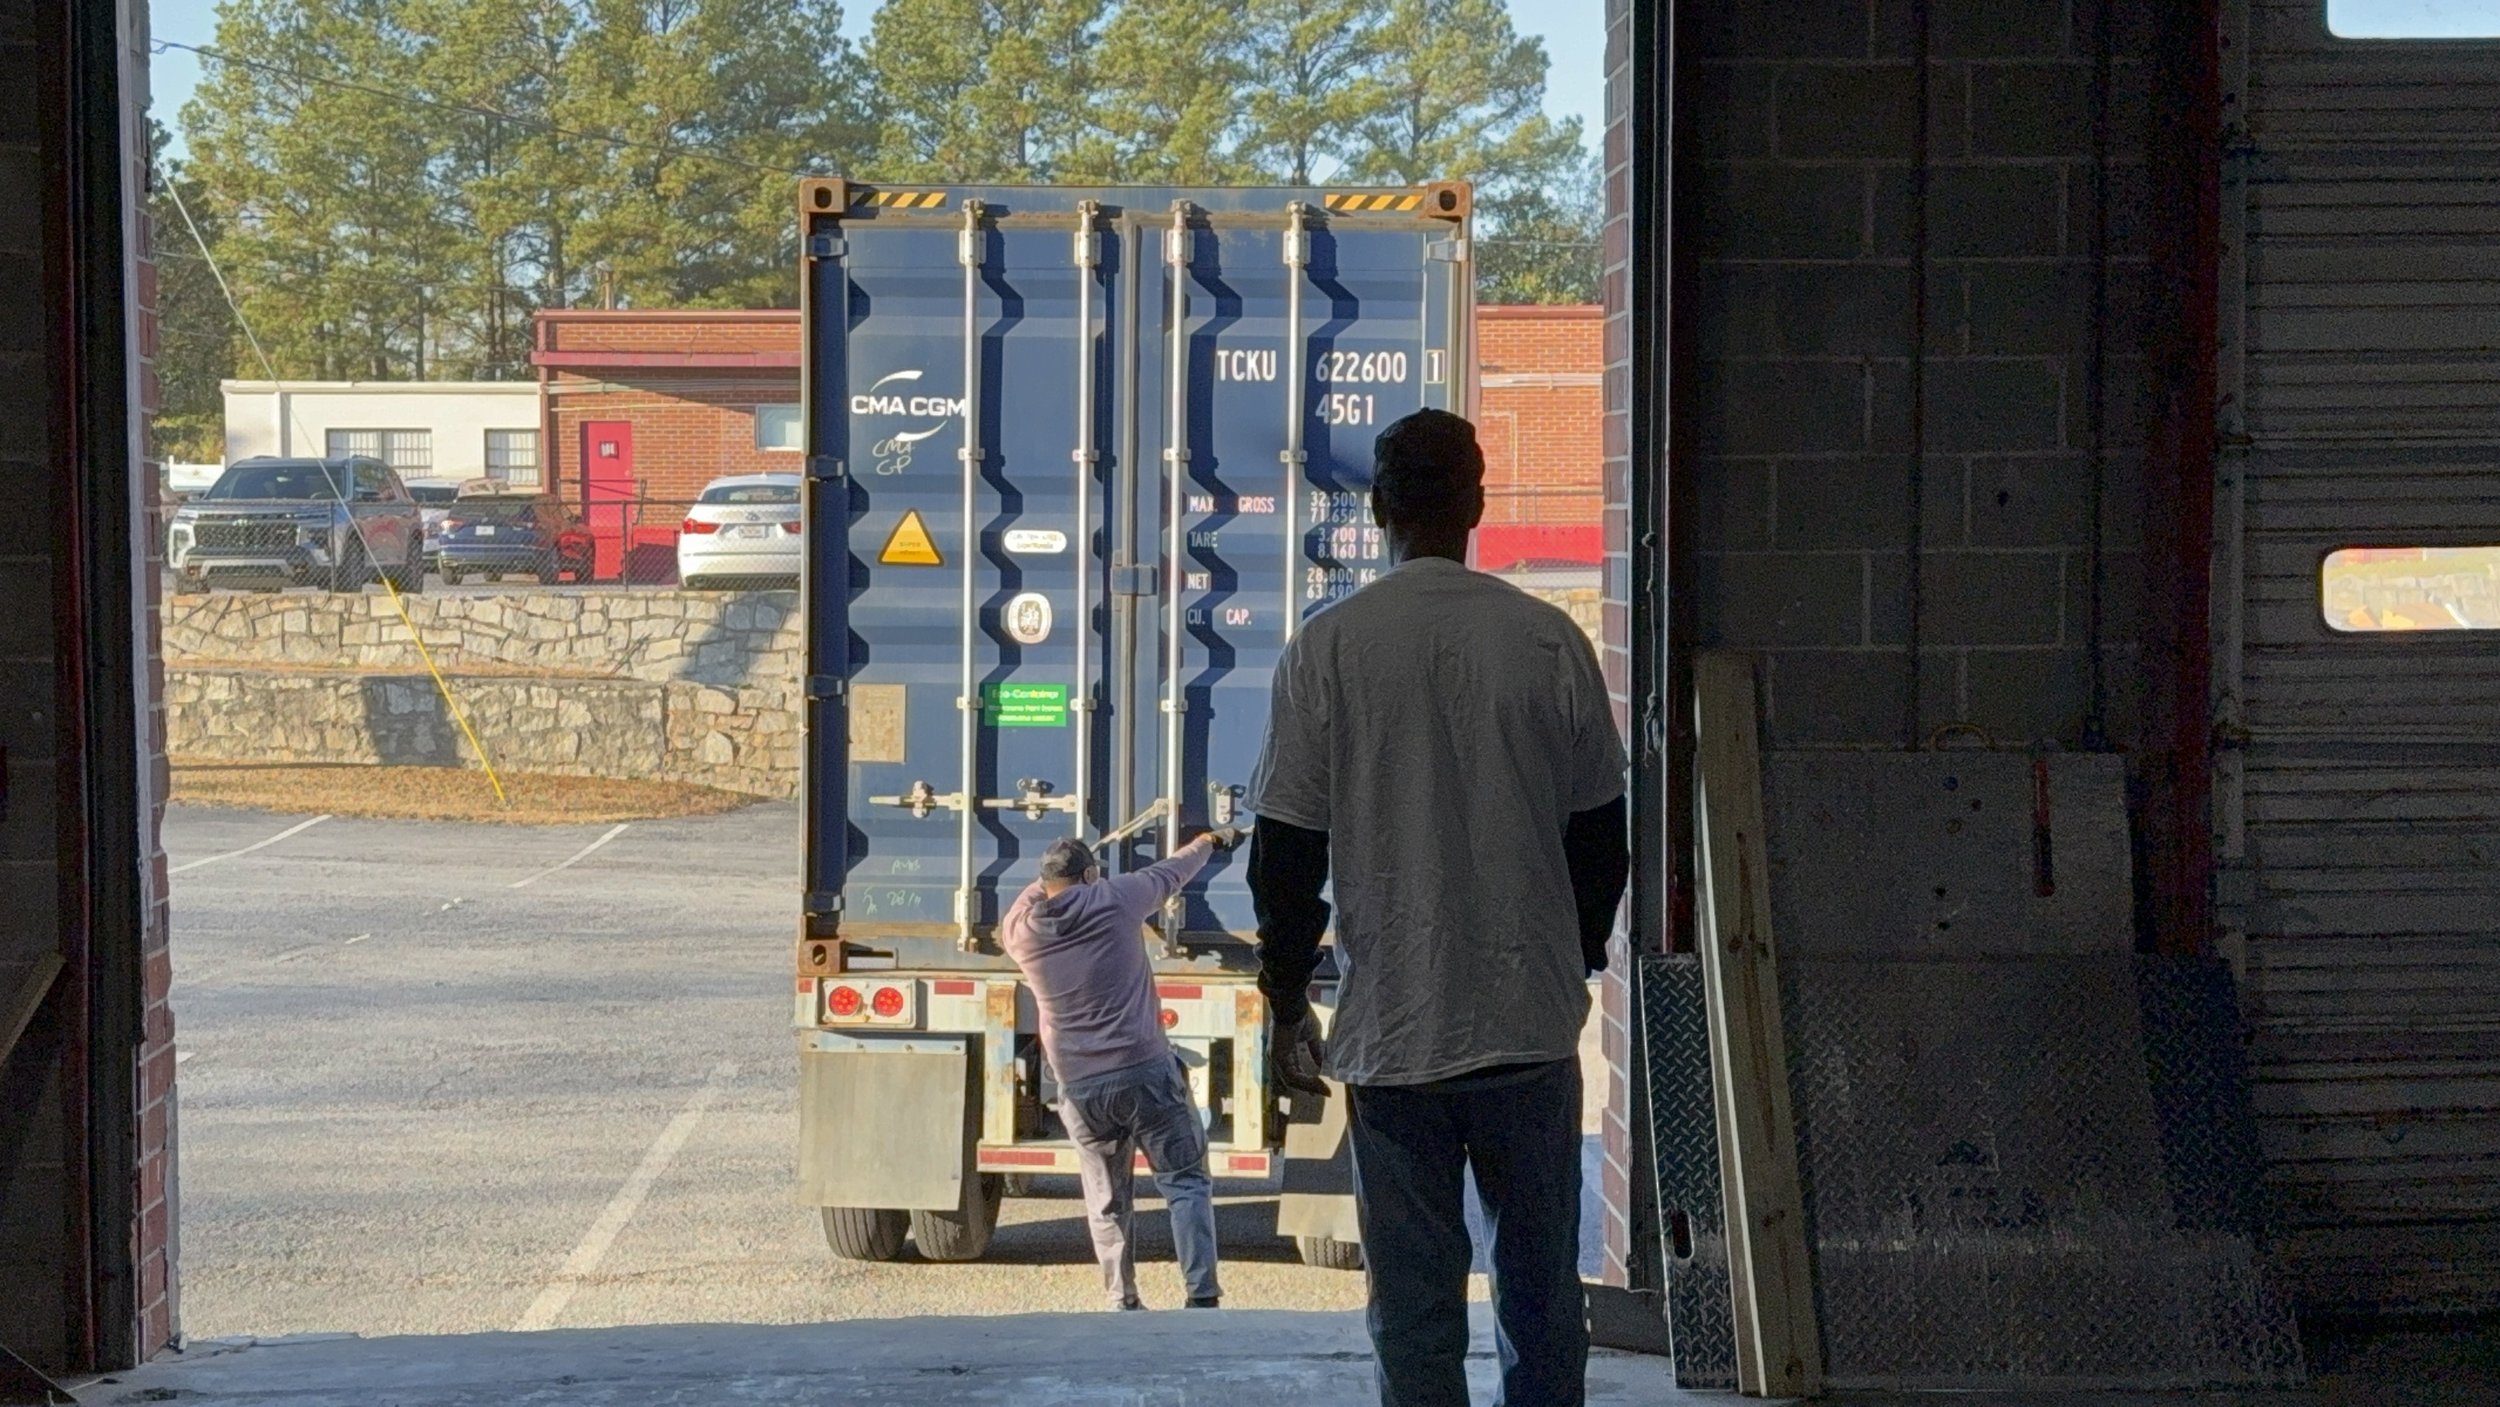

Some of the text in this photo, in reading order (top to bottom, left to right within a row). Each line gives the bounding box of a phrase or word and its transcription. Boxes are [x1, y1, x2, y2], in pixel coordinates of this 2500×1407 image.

[1217, 350, 1277, 381] TCKU
[1315, 352, 1407, 382] 622600
[851, 395, 966, 417] CMA CGM
[1315, 394, 1374, 425] 45G1
[1190, 496, 1218, 512] MAX.
[1238, 497, 1275, 513] GROSS
[1364, 492, 1372, 508] K
[1363, 509, 1375, 523] L
[1190, 531, 1218, 548] TARE
[1363, 528, 1379, 543] KG
[1363, 543, 1379, 559] LB
[1187, 573, 1209, 590] NET
[1360, 568, 1377, 584] KG
[1187, 609, 1252, 625] CU. CAP.
